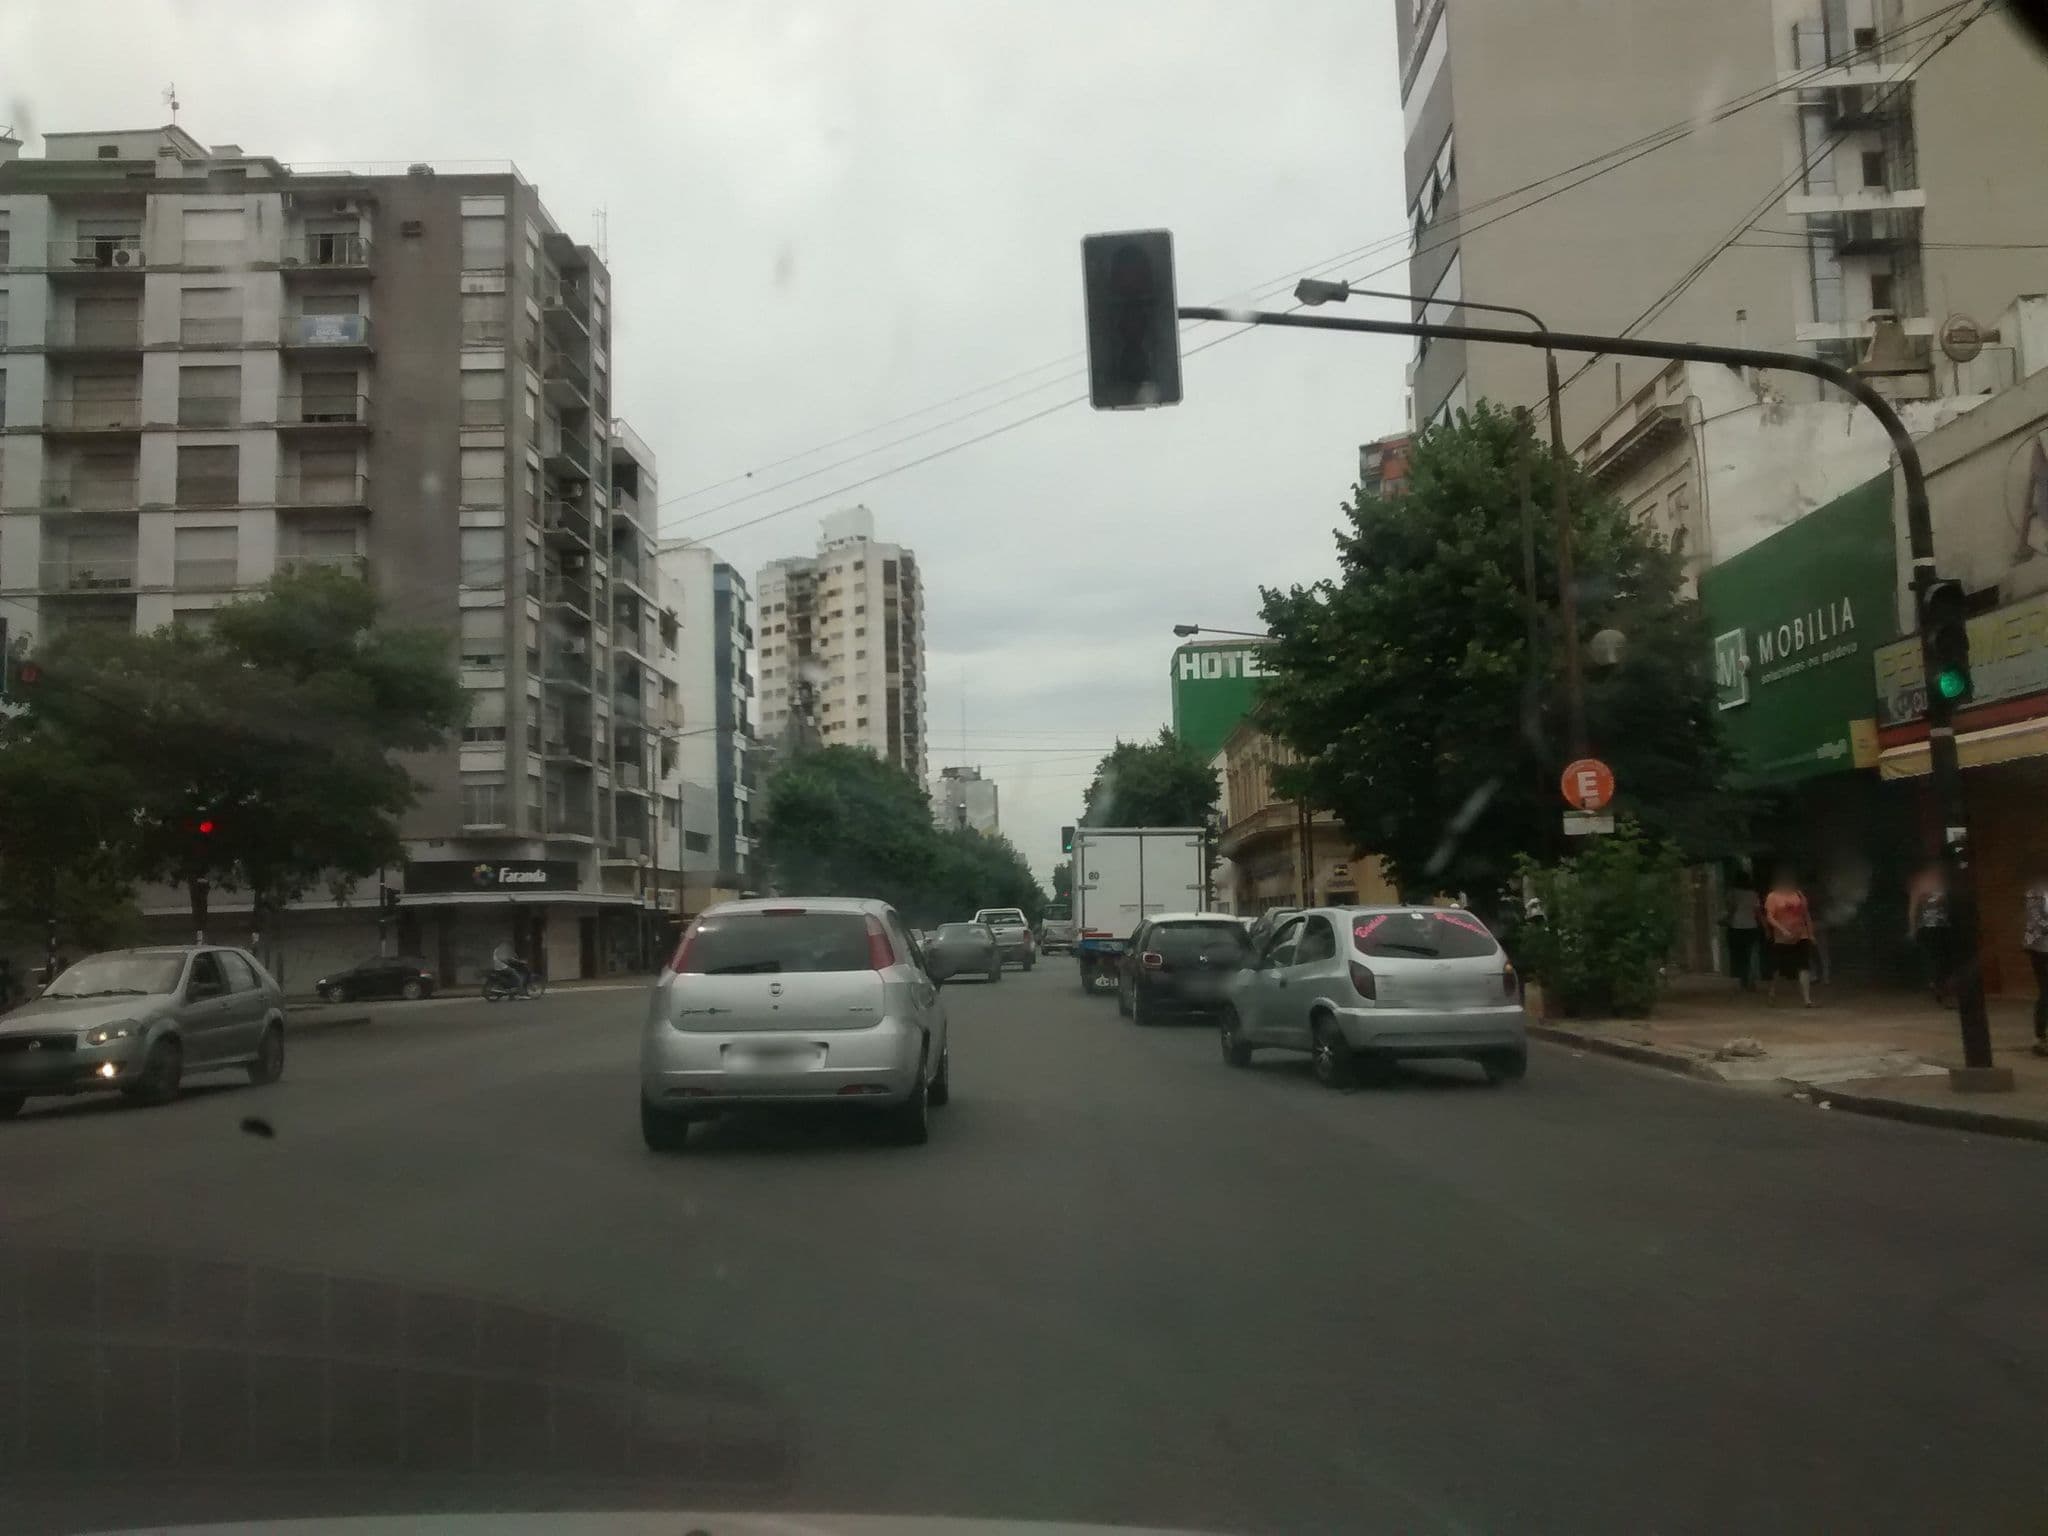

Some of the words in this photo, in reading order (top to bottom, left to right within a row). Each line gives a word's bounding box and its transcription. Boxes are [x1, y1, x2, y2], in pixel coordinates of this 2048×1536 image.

[1759, 597, 1855, 665] MOBILIA
[1577, 771, 1600, 798] E
[498, 867, 547, 883] Faranda
